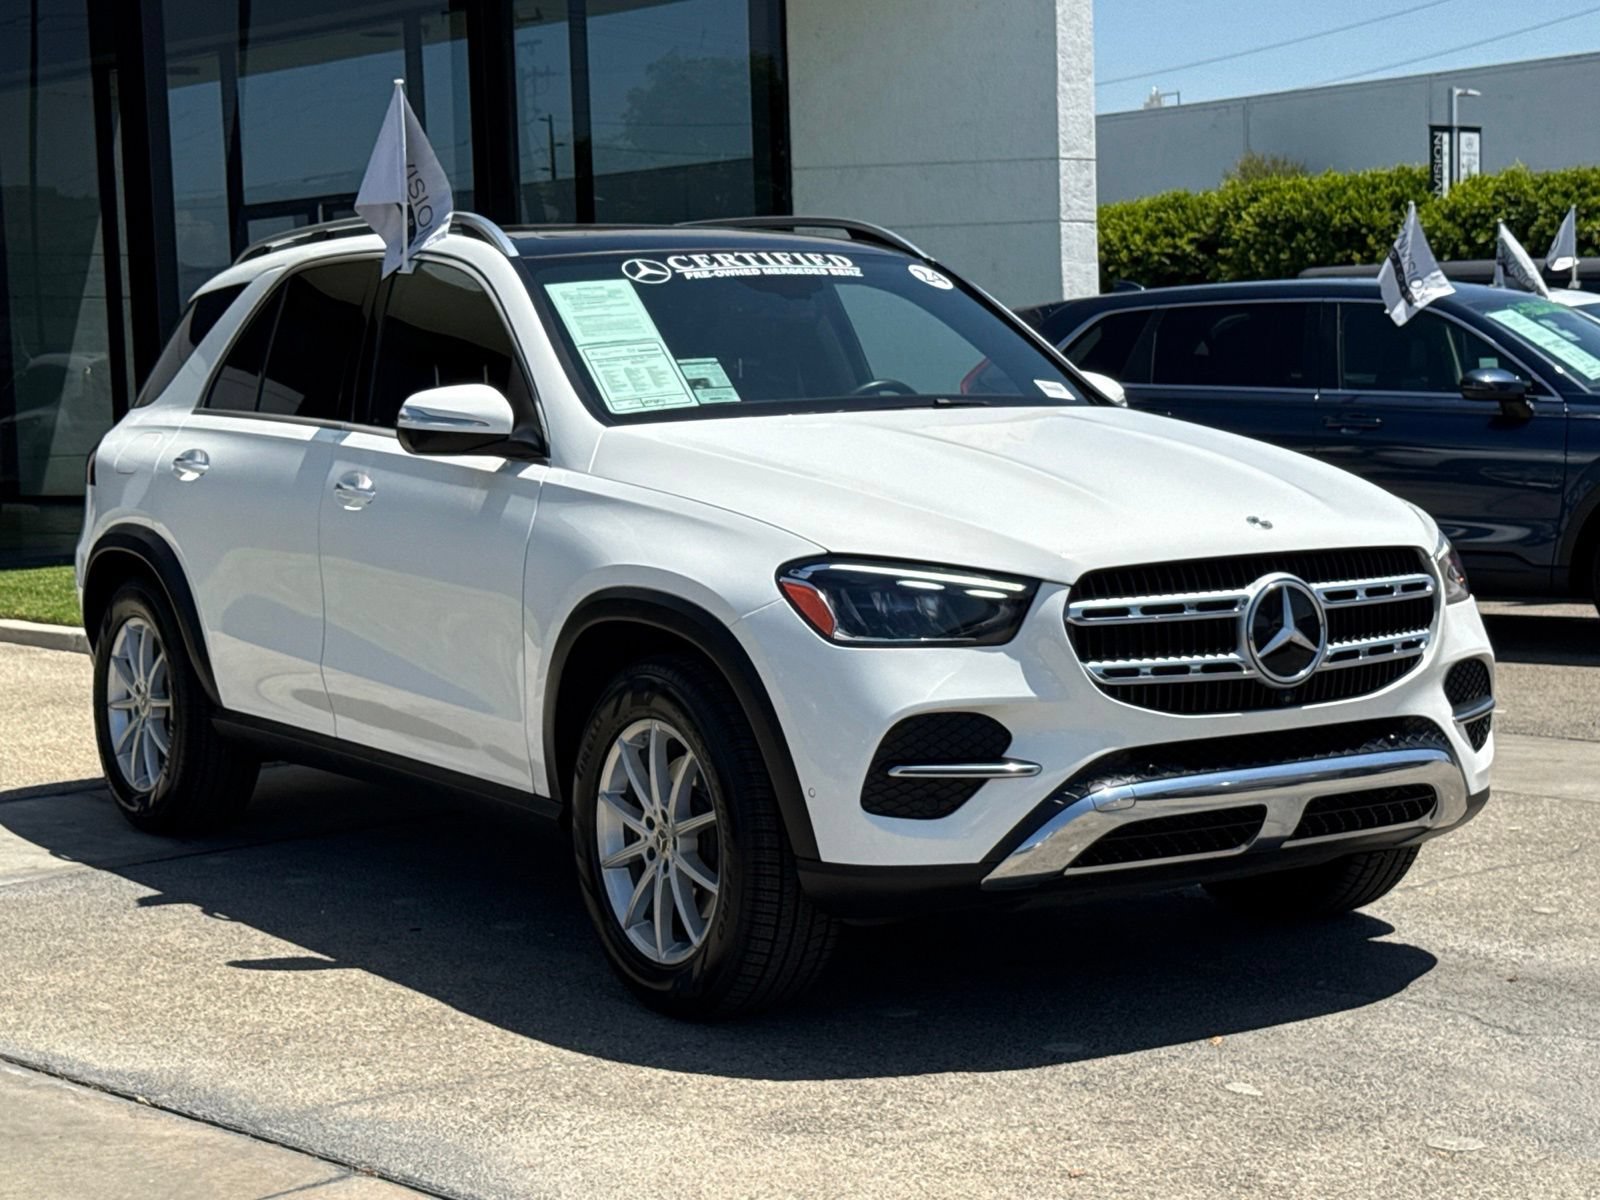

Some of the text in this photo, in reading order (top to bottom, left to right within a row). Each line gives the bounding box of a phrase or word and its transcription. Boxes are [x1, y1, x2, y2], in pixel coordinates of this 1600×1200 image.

[667, 252, 854, 270] CERTIFIED
[683, 267, 864, 280] PRE-OWNED MERCEDES BENZ
[912, 268, 950, 286] 24
